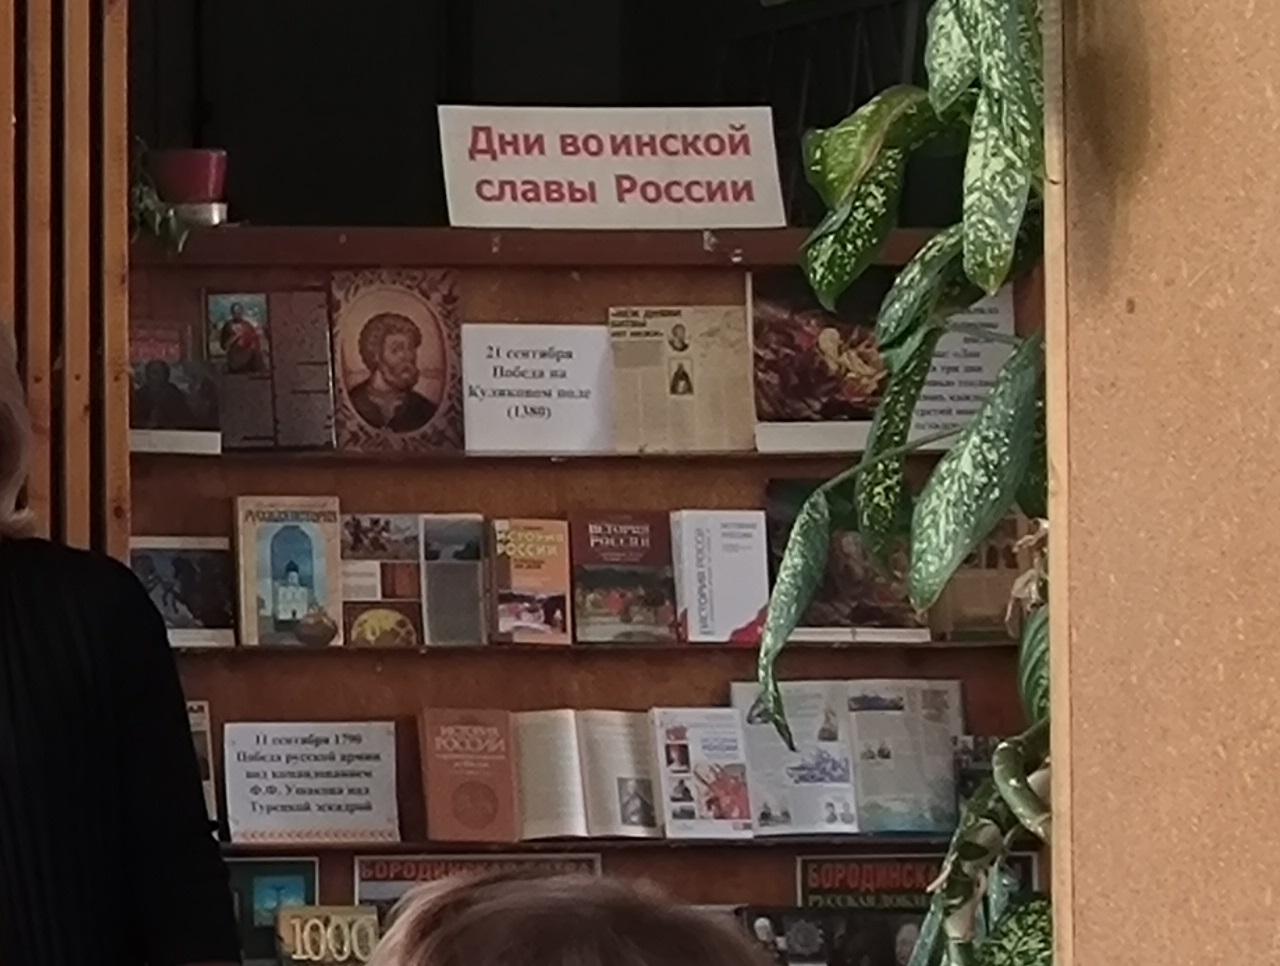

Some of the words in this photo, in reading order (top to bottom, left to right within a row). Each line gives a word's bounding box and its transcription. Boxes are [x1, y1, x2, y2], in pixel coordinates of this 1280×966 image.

[467, 124, 546, 162] Дни
[559, 123, 752, 158] воинской
[474, 177, 598, 204] славы
[613, 173, 756, 204] России
[290, 916, 377, 962] 1000
